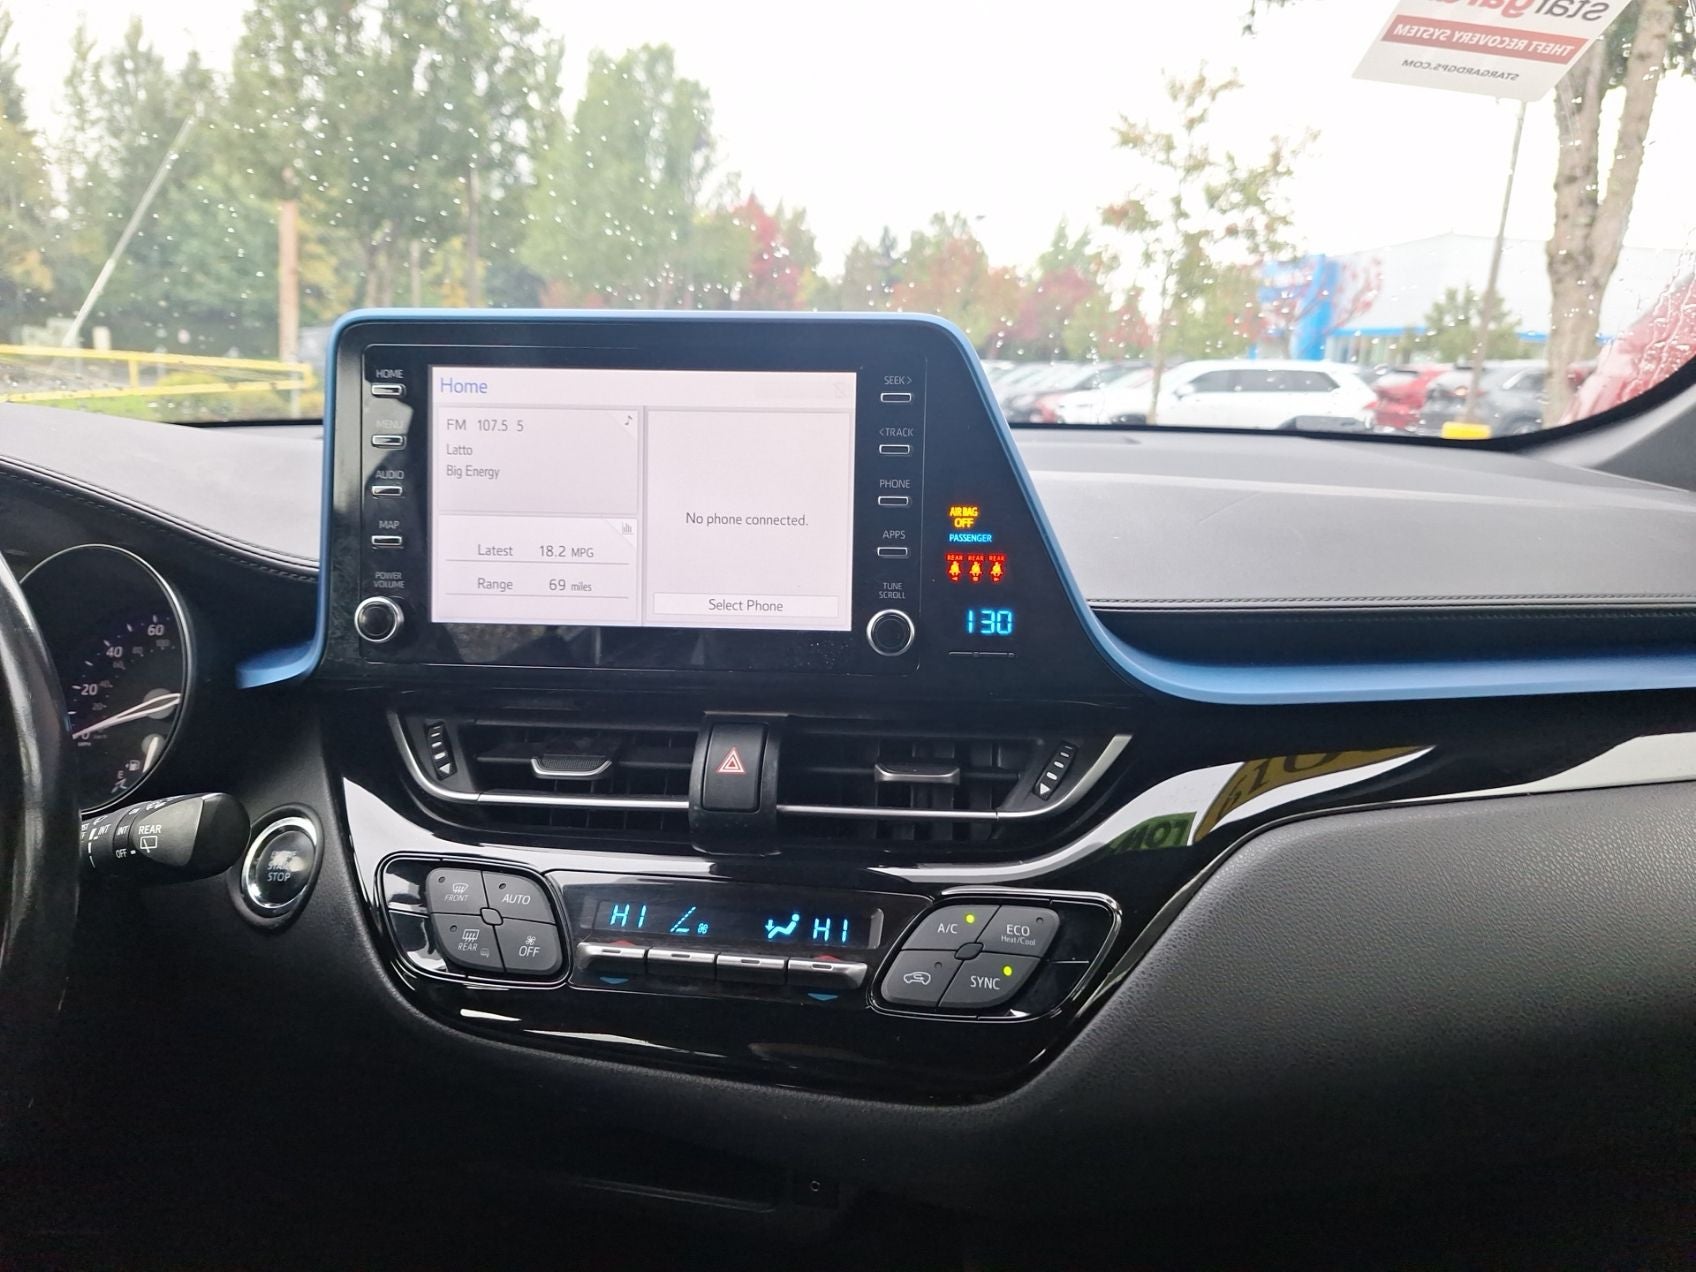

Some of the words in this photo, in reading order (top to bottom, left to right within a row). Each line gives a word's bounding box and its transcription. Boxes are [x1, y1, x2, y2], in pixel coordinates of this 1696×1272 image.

[375, 369, 404, 378] HOME
[440, 377, 488, 394] Home
[446, 418, 467, 431] FM
[477, 419, 508, 432] 107.5
[516, 419, 524, 432] 5
[446, 443, 473, 455] Latto
[375, 470, 405, 479] AUDIO
[446, 464, 463, 479] Big
[465, 464, 500, 480] Energy
[879, 479, 910, 488] PHONE
[379, 520, 401, 529] MAP
[685, 511, 704, 524] No
[706, 512, 743, 527] phone
[745, 514, 809, 526] connected.
[954, 517, 974, 528] OFF
[882, 530, 906, 539] APPS
[949, 533, 992, 542] PASSENGER
[477, 543, 514, 557] Latest
[539, 544, 567, 558] 18.2
[570, 547, 594, 558] MPG
[375, 571, 402, 579] POWER
[373, 580, 405, 588] VOLUME
[477, 577, 514, 592] Range
[548, 578, 567, 591] 69
[570, 581, 593, 592] miles
[882, 582, 903, 590] TUNE
[879, 591, 906, 599] SCROLL
[708, 598, 744, 611] Select
[746, 599, 784, 612] Phone
[147, 624, 164, 636] 60
[106, 646, 123, 658] 40
[81, 684, 98, 696] 20
[138, 824, 162, 835] REAR
[115, 848, 128, 859] OFF
[267, 871, 291, 882] STOP
[444, 894, 469, 902] FRONT
[502, 893, 531, 905] AUTO
[937, 923, 959, 934] A/C
[1006, 924, 1030, 936] ECO
[1000, 934, 1036, 946] Heat/Cool
[457, 942, 478, 952] REAR
[518, 945, 541, 958] OFF
[970, 975, 1001, 990] SYNC
